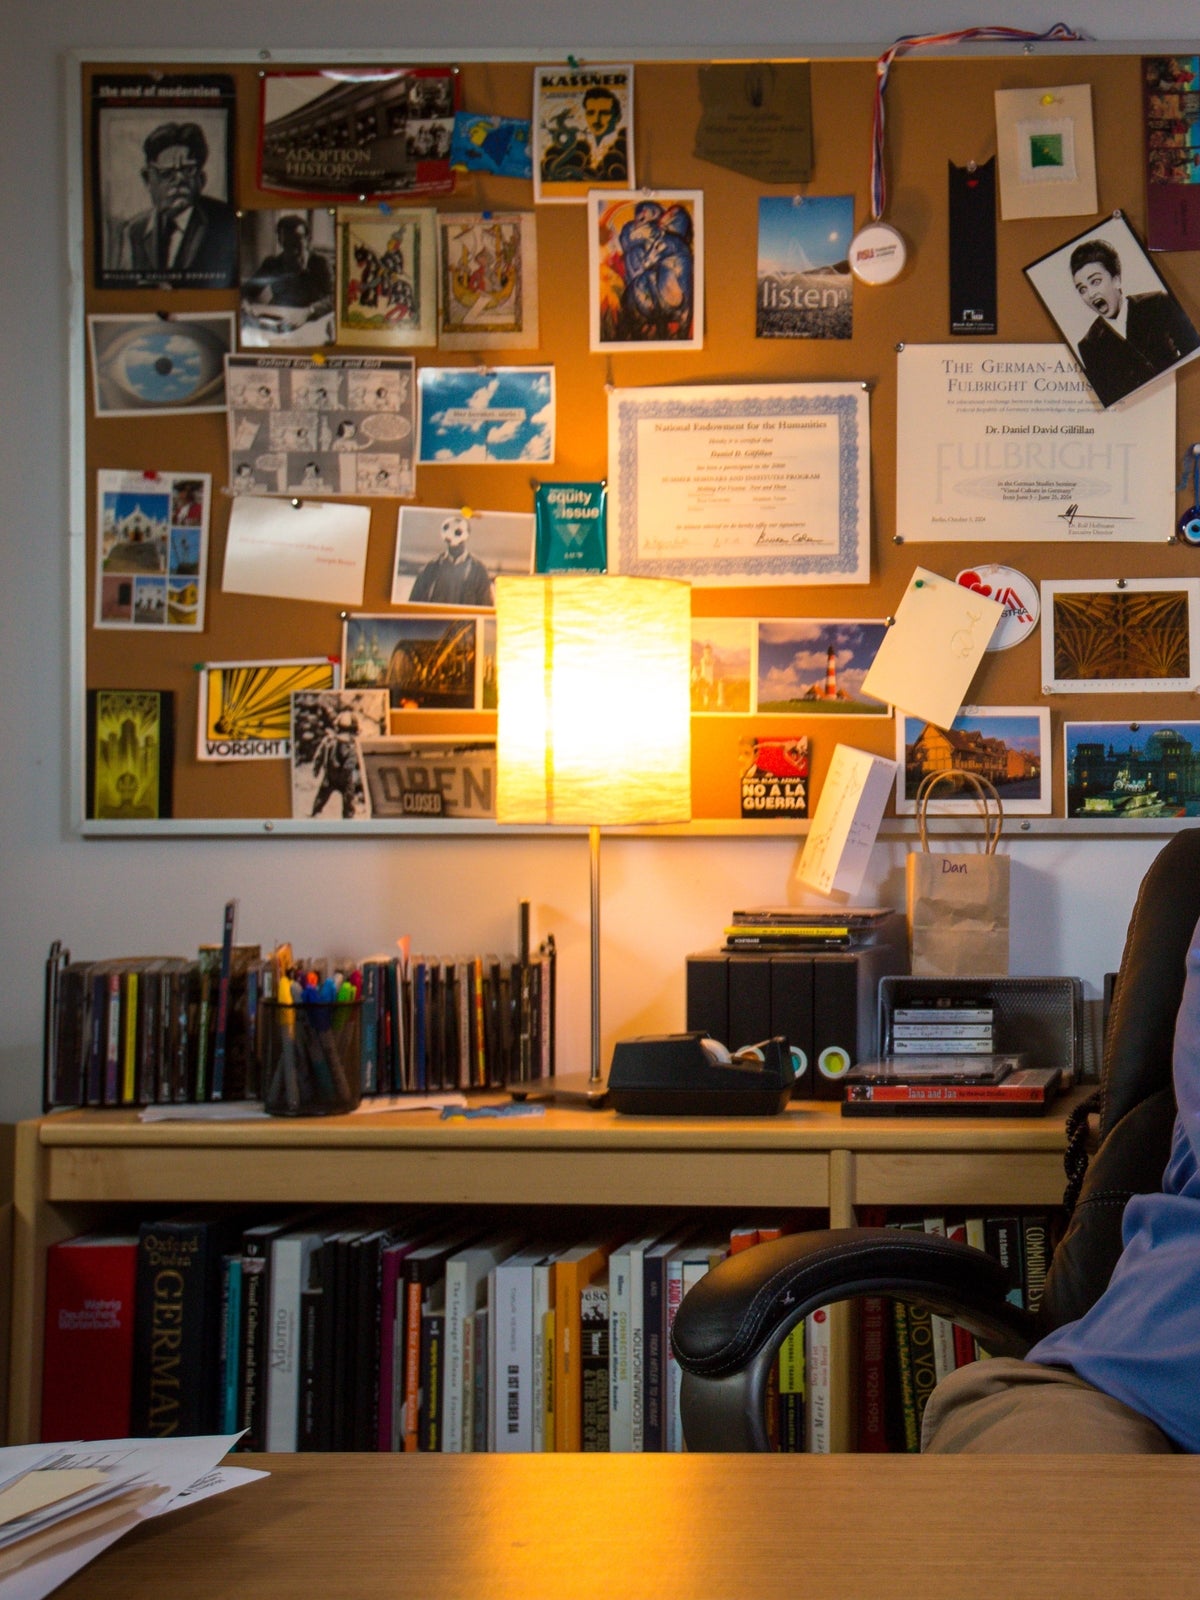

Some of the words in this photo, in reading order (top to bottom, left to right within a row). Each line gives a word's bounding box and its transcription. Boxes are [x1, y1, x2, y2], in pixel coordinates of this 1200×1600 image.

[157, 85, 221, 96] modernism
[541, 75, 627, 87] KASSNER
[285, 149, 371, 162] ADOPTION
[285, 162, 355, 178] HISTORY
[942, 360, 973, 373] THE
[981, 360, 1087, 373] GERMAN-AM
[947, 378, 1027, 392] FULBRIGHT
[1034, 378, 1093, 392] COMMIS
[655, 422, 690, 432] National
[693, 421, 744, 432] Endowment
[747, 421, 760, 431] for
[762, 420, 775, 430] the
[778, 419, 827, 430] Humanities
[985, 425, 1000, 434] Dr.
[1001, 425, 1030, 434] Daniel
[1032, 425, 1058, 434] David
[1060, 425, 1095, 435] Gilfillan
[547, 489, 592, 506] equity
[206, 740, 281, 756] VORSICHT
[377, 766, 491, 811] OPEN
[743, 784, 766, 797] NO
[770, 783, 781, 797] A
[785, 783, 805, 796] LA
[404, 793, 441, 813] CLOSED
[743, 796, 806, 810] GUERRA
[942, 859, 968, 874] Dan
[908, 1087, 925, 1099] Jana
[928, 1087, 942, 1099] and
[944, 1087, 958, 1099] Jan
[143, 1234, 199, 1253] Oxford
[149, 1252, 192, 1267] Duden
[1025, 1227, 1046, 1301] COMMUNITIES
[248, 1276, 259, 1306] Visual
[453, 1281, 461, 1297] The
[668, 1279, 682, 1305] RADIO
[59, 1309, 117, 1320] Deutsches
[84, 1299, 122, 1311] Wahrig
[408, 1283, 419, 1329] Handbook
[58, 1319, 122, 1329] Wörterbuch
[247, 1307, 258, 1345] Culture
[451, 1300, 460, 1341] Language
[910, 1305, 931, 1346] DIO
[271, 1308, 286, 1374] Adorno
[408, 1330, 418, 1346] for
[534, 1333, 542, 1356] What
[592, 1333, 601, 1356] Turner
[619, 1311, 628, 1382] CONNECTIONS
[649, 1333, 659, 1356] FROM
[149, 1269, 184, 1438] GERMAN
[246, 1347, 257, 1366] and
[452, 1343, 460, 1354] of
[900, 1347, 910, 1368] Radio
[246, 1368, 257, 1384] the
[407, 1348, 417, 1391] Academic
[451, 1356, 460, 1388] Silence
[508, 1365, 519, 1375] ER
[533, 1371, 543, 1386] Gay
[584, 1369, 596, 1378] &
[611, 1356, 619, 1383] History
[649, 1358, 659, 1384] HITLER
[508, 1376, 519, 1388] IST
[584, 1380, 596, 1399] THE
[596, 1368, 607, 1409] GERMAN
[632, 1328, 642, 1443] TELECOMMUNICATION
[649, 1386, 659, 1396] TO
[902, 1370, 912, 1405] Handbook
[913, 1351, 937, 1421] VOIC
[508, 1391, 519, 1421] WIEDER
[534, 1388, 543, 1407] Men
[866, 1366, 879, 1433] 1920-1950
[407, 1393, 416, 1431] Authors
[584, 1401, 596, 1422] RISE
[814, 1394, 825, 1429] Merle
[508, 1422, 519, 1434] DA
[584, 1425, 596, 1438] OF
